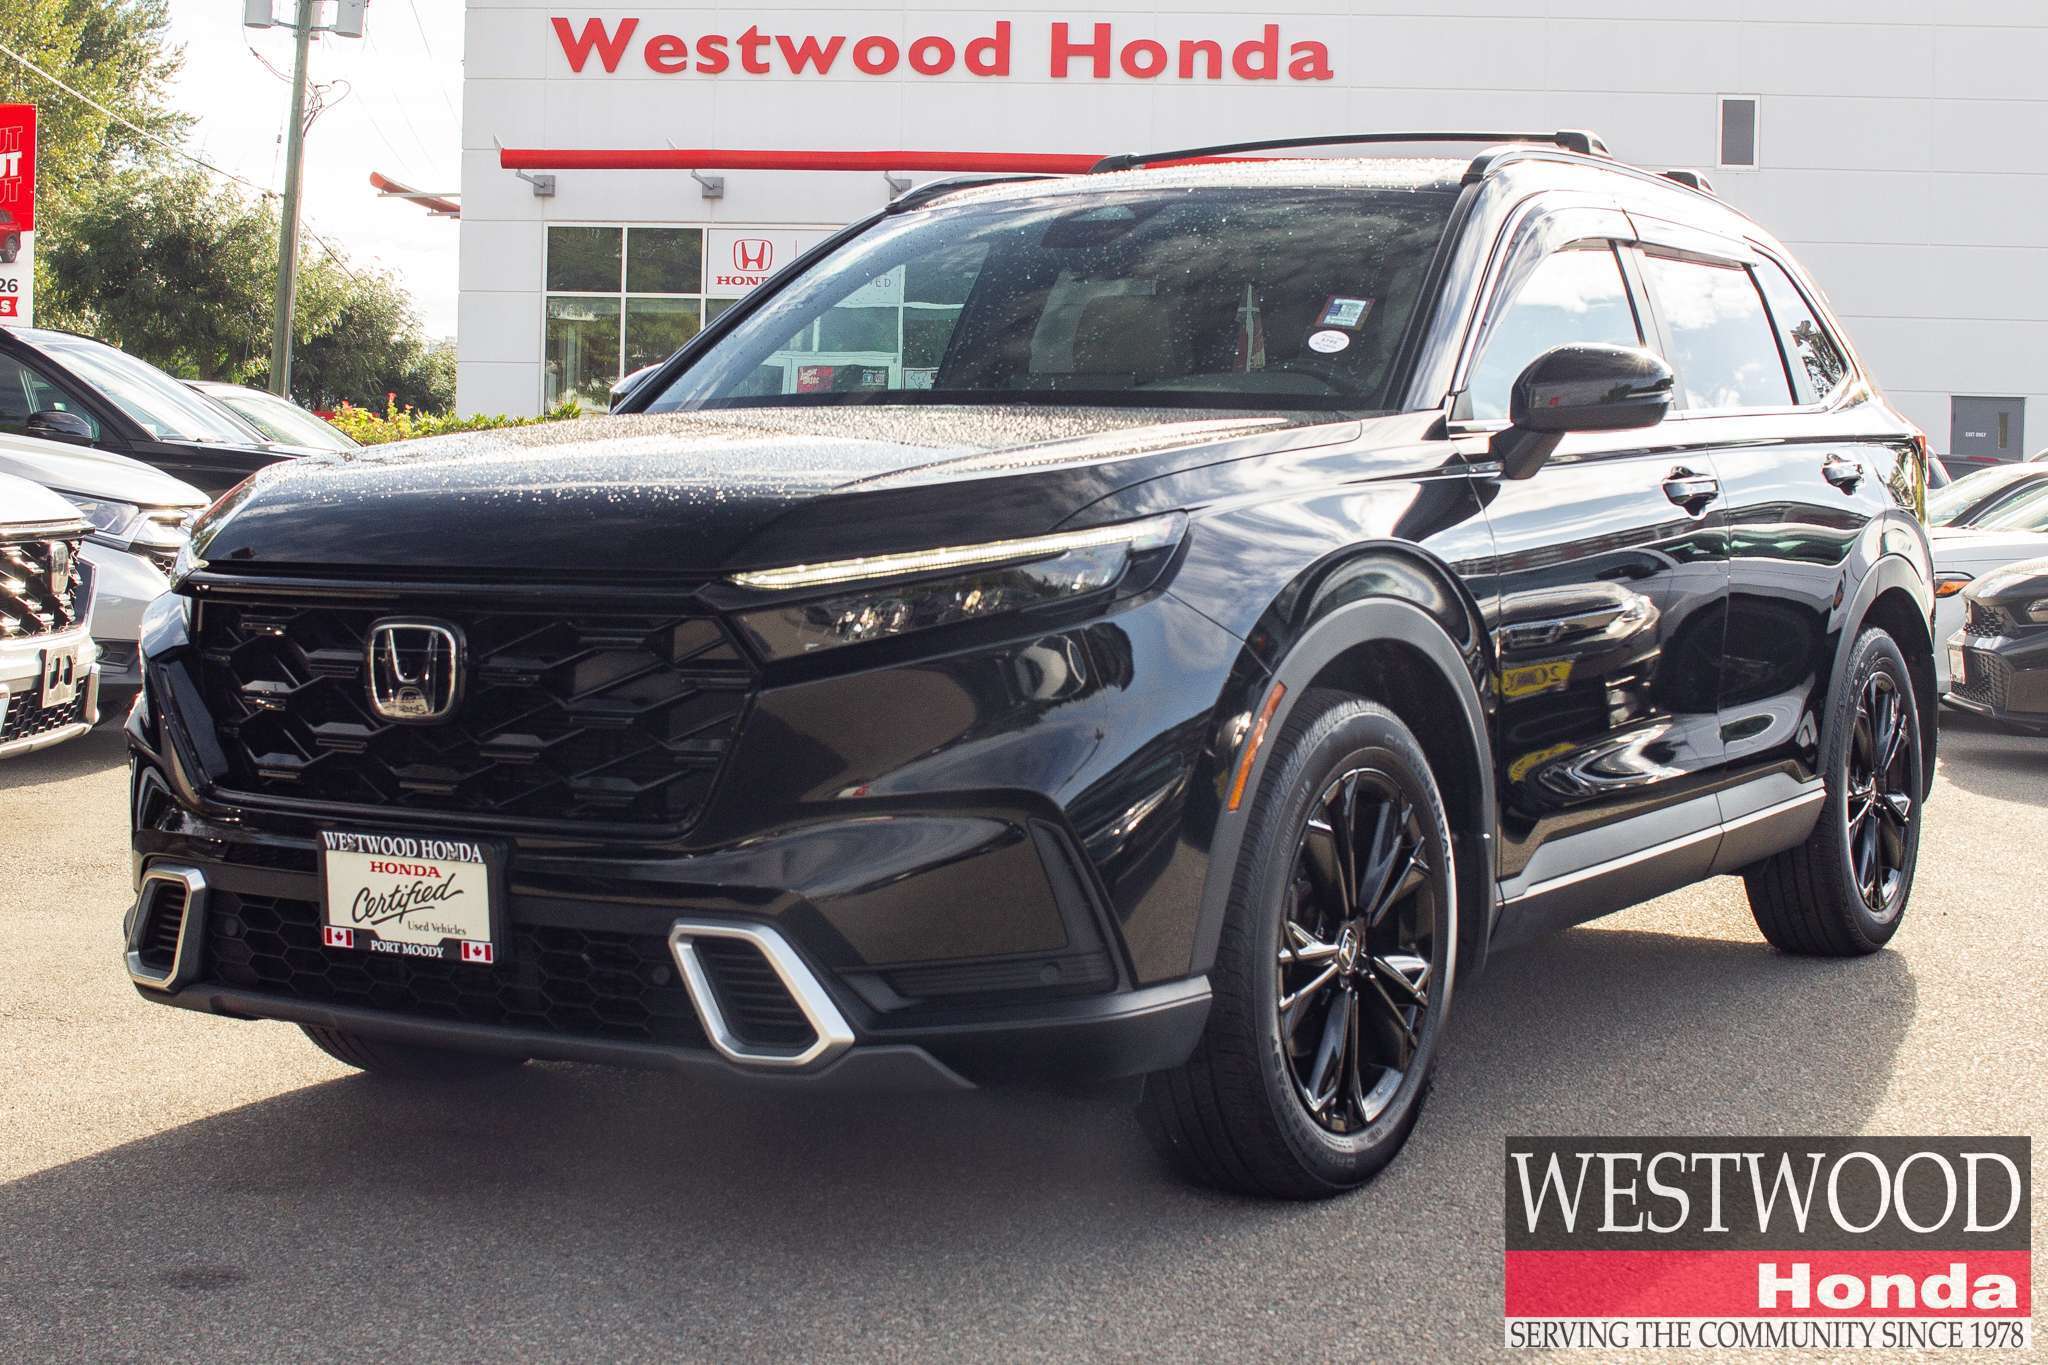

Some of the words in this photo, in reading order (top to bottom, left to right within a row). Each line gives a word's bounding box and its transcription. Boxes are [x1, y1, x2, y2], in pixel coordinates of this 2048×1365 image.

[550, 16, 1012, 77] Westwood
[1049, 21, 1335, 82] Honda
[716, 276, 768, 286] HON
[322, 831, 417, 858] WESTWOOD
[420, 839, 484, 864] HONDA
[369, 861, 442, 878] HONDA
[352, 873, 464, 925] Certified
[407, 920, 430, 932] Used
[433, 923, 467, 936] Vehicles
[370, 940, 401, 954] PORT
[402, 943, 444, 959] MOODY
